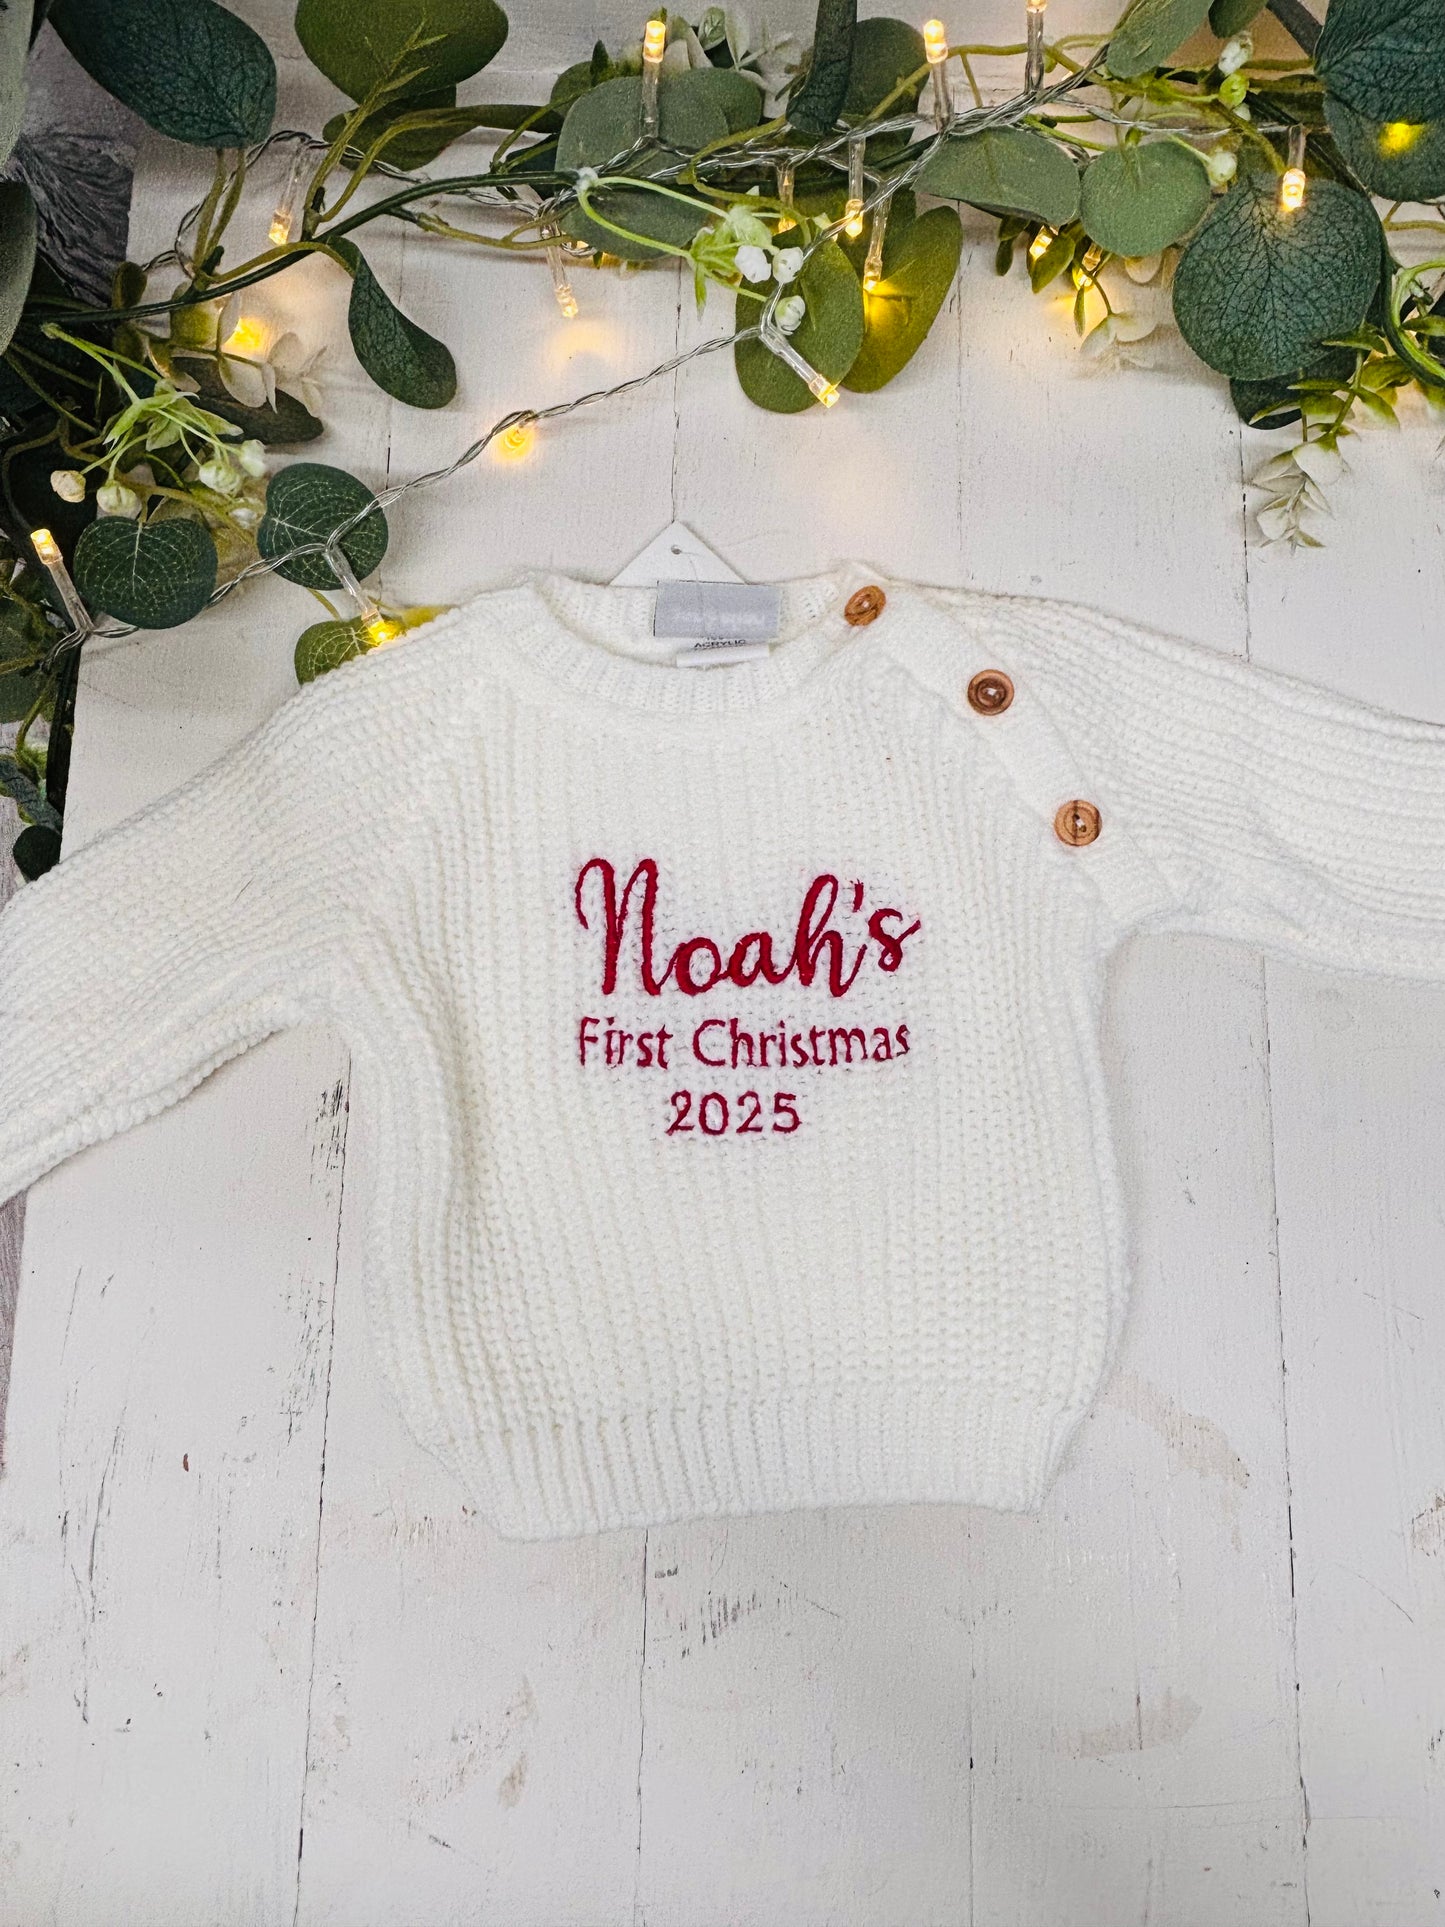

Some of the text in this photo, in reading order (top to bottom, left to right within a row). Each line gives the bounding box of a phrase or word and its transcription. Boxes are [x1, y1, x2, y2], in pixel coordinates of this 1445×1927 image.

[574, 857, 922, 998] Noah's
[578, 1016, 911, 1070] First Christmas
[666, 1089, 803, 1136] 2025
